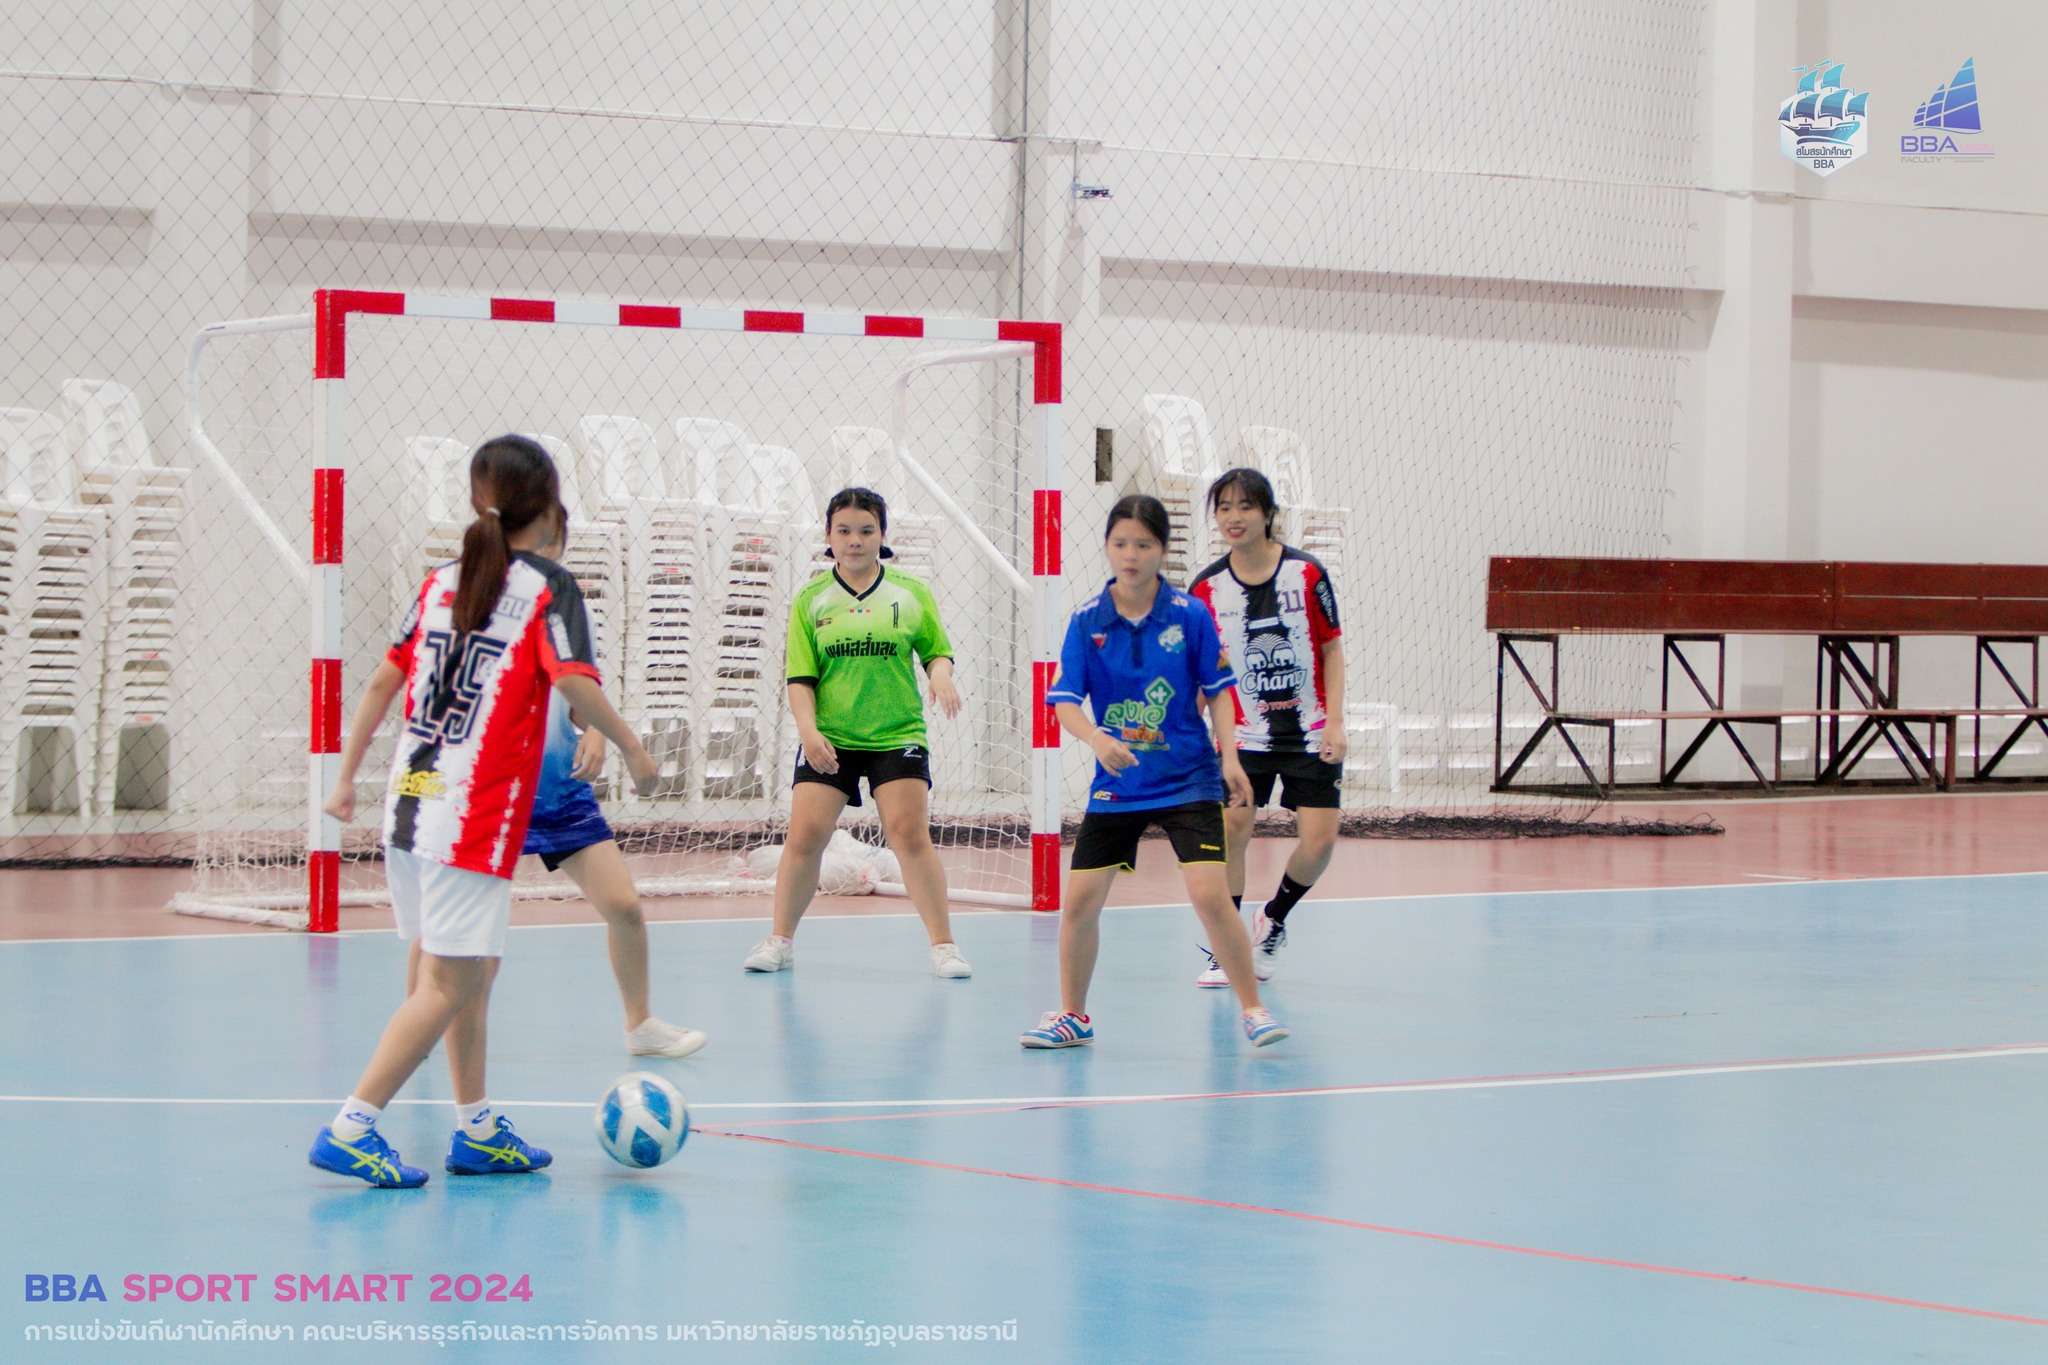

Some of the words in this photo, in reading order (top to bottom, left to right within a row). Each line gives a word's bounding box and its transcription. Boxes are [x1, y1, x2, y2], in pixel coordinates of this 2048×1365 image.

[1282, 589, 1305, 613] 11
[890, 601, 899, 629] 1
[1240, 669, 1307, 695] Chang
